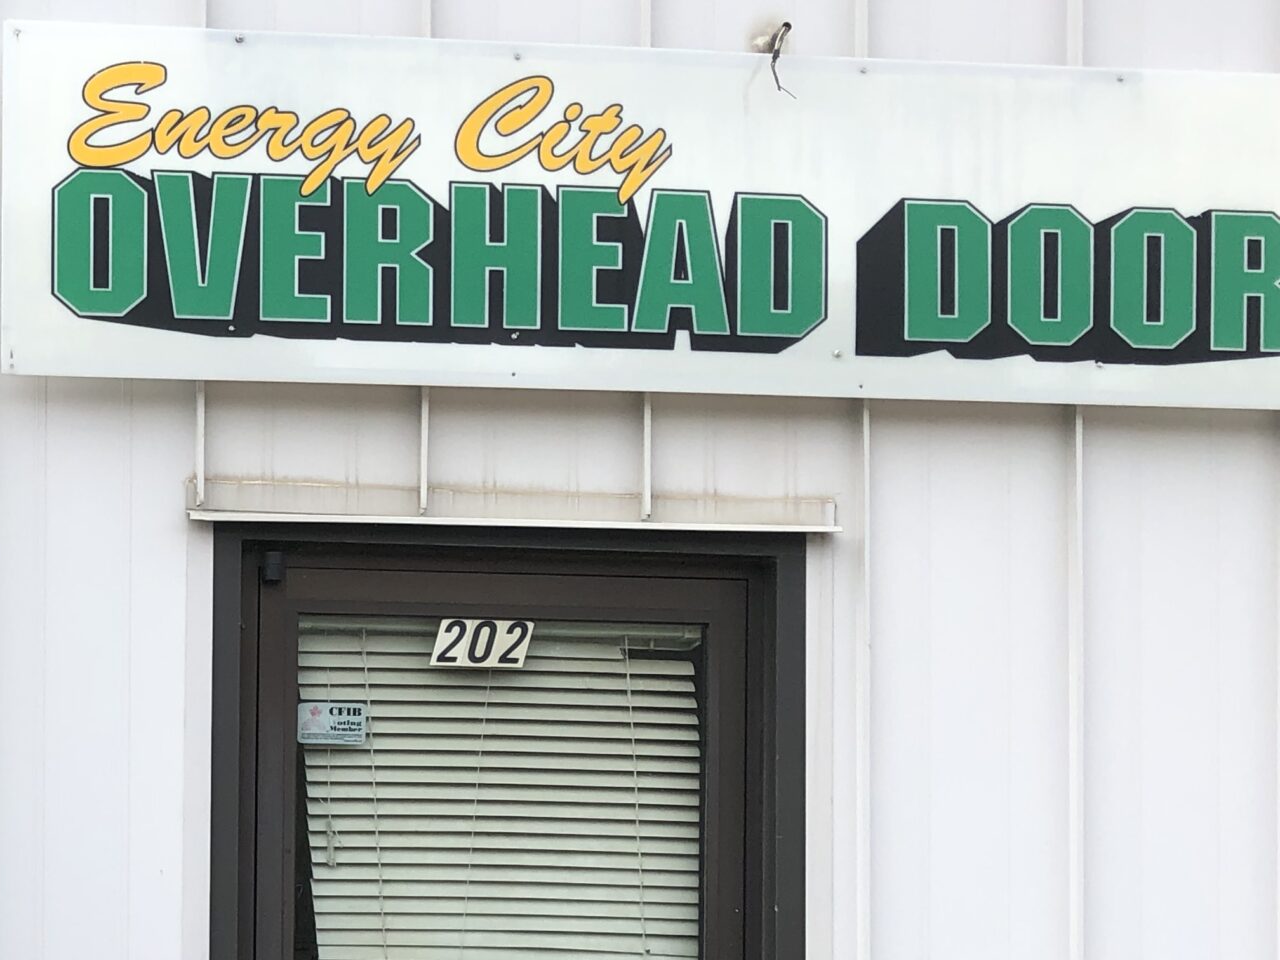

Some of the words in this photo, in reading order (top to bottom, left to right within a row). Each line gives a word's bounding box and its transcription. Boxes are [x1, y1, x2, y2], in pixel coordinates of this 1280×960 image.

[68, 61, 421, 196] Energy
[454, 75, 672, 204] City
[51, 167, 828, 342] OVERHEAD
[436, 619, 529, 664] 202
[329, 706, 362, 717] CFIB
[329, 719, 362, 727] oting
[329, 725, 362, 733] Member
